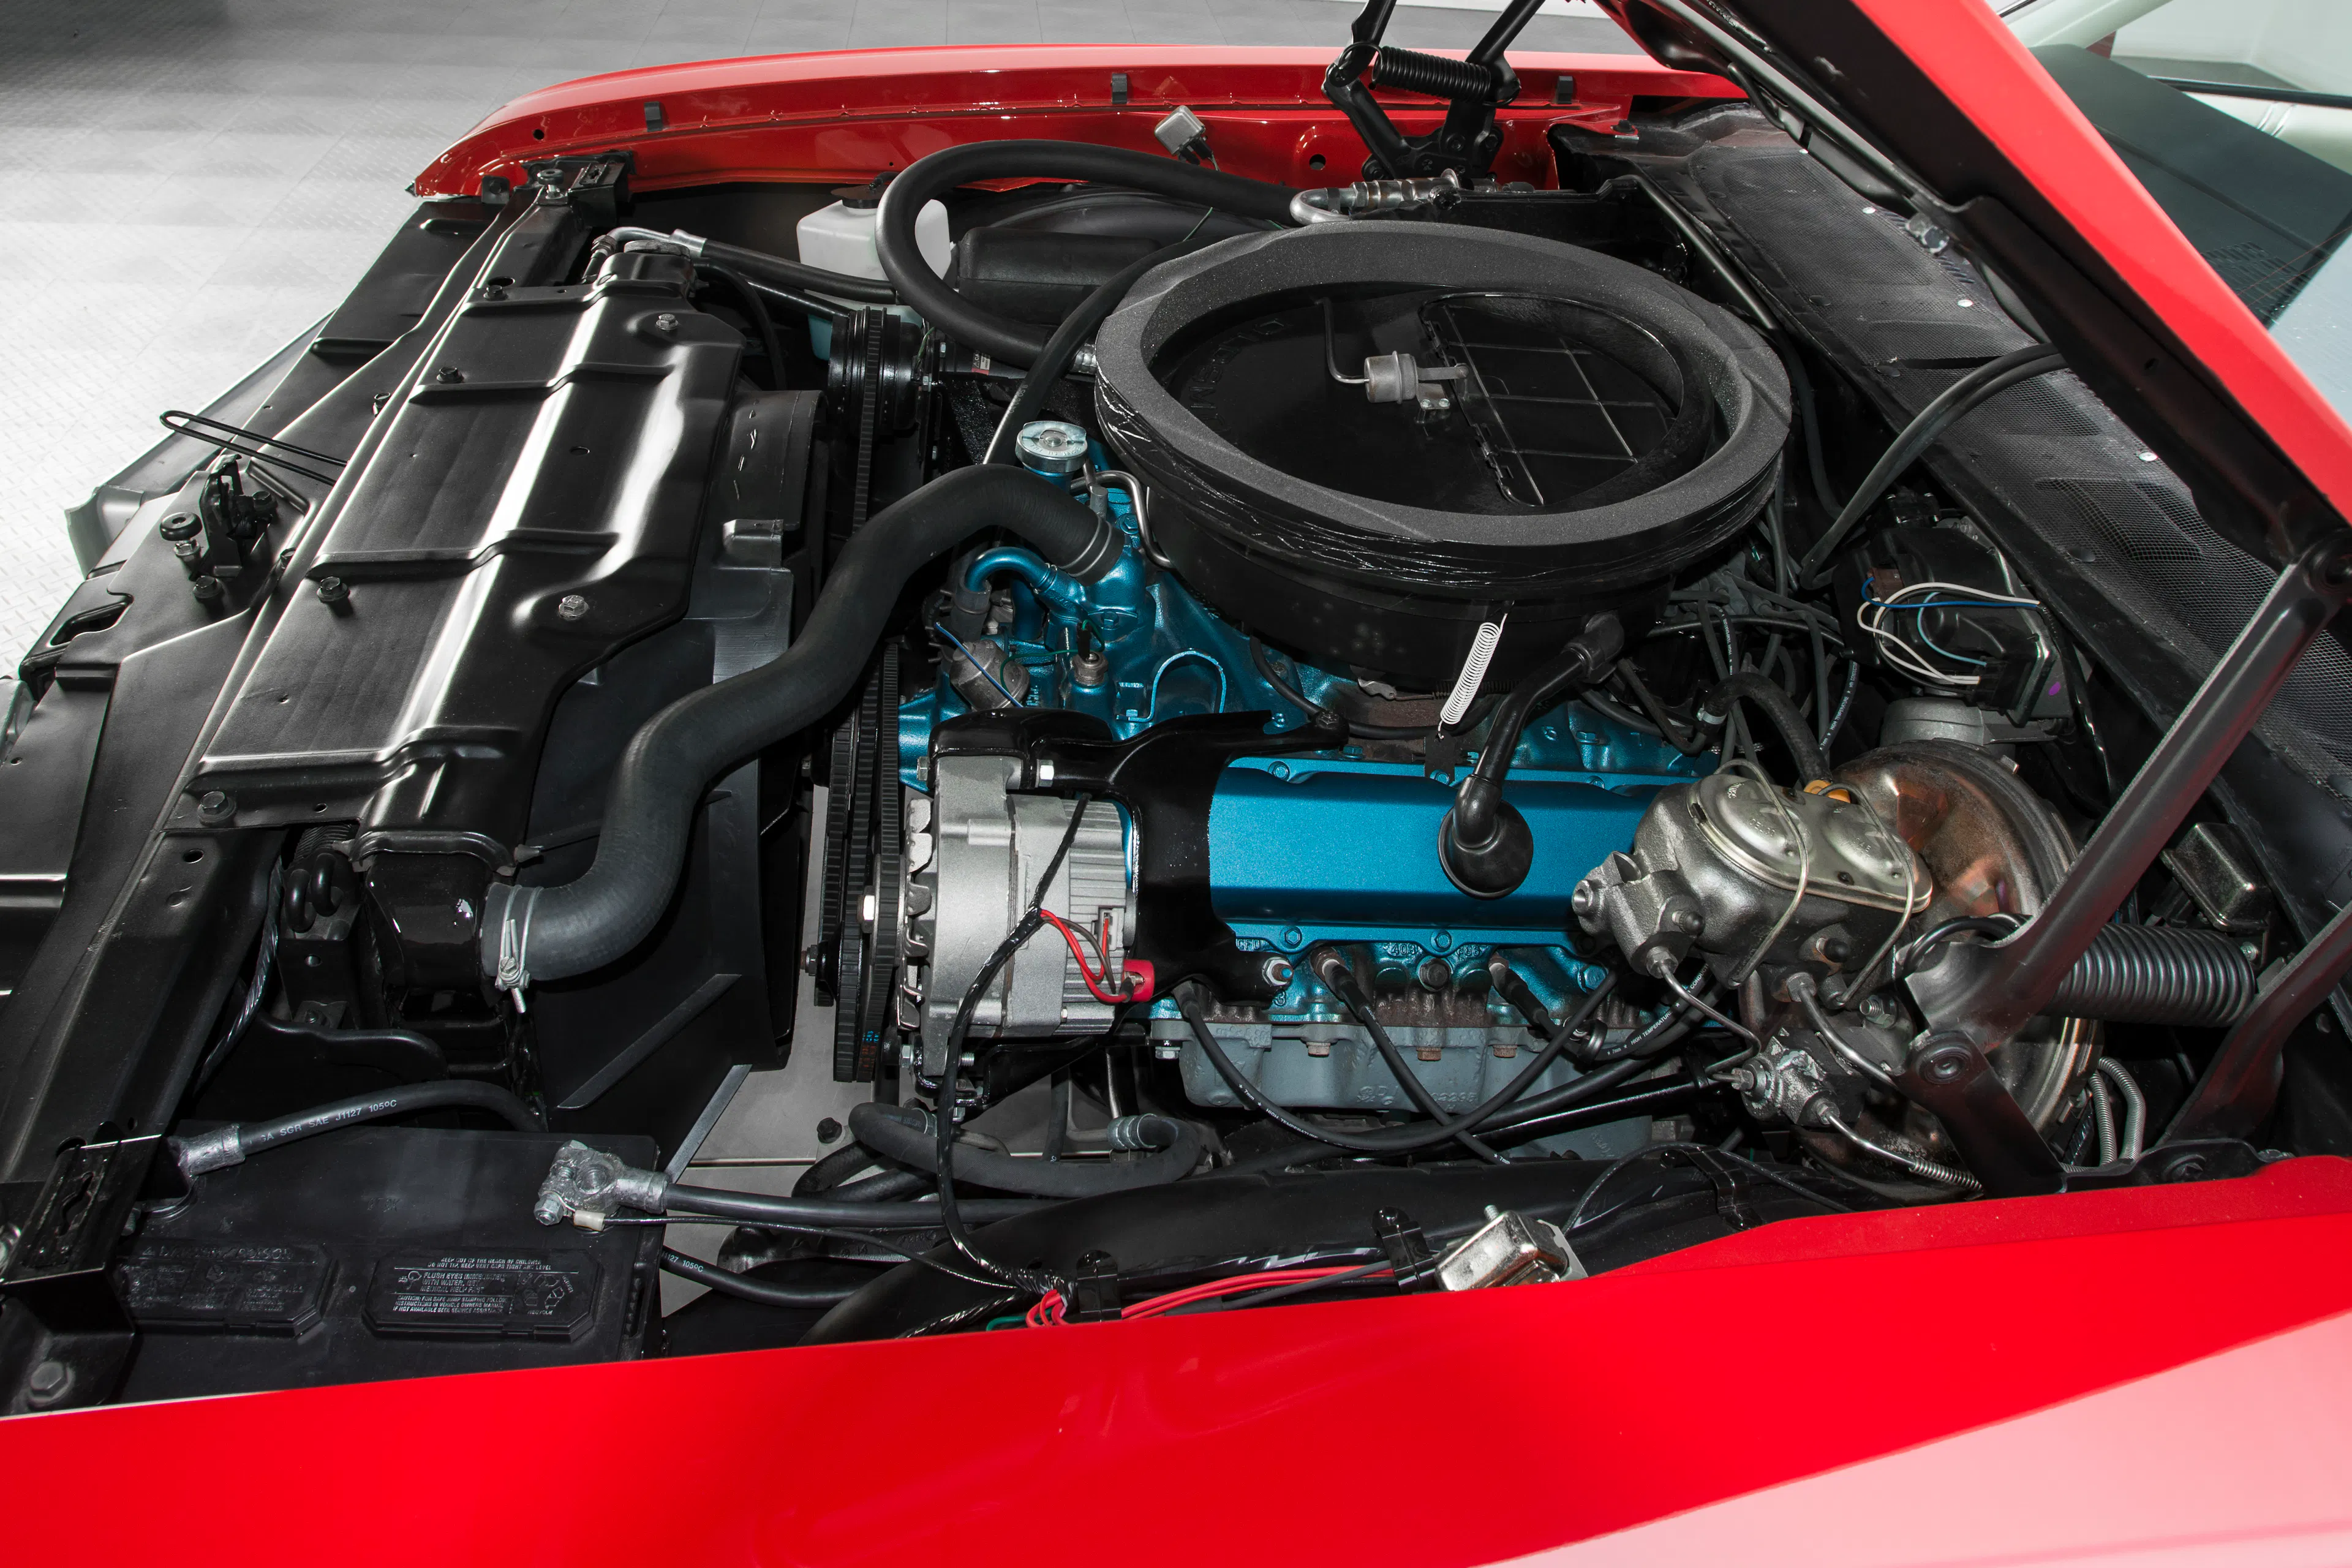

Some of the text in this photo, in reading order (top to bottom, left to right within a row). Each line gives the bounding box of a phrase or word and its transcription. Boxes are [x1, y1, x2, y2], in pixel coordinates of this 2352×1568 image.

[1835, 696, 1850, 721] TEMPERATURE
[1391, 943, 1416, 956] 403
[1630, 1035, 1642, 1046] HIGH
[1642, 1010, 1673, 1038] TEMPERATURE
[1243, 1089, 1255, 1101] 7mm
[1265, 1107, 1279, 1120] HIGH
[280, 1125, 303, 1137] SGR
[308, 1117, 329, 1128] SAE
[336, 1107, 363, 1121] J1127
[1499, 1155, 1511, 1165] 7mm
